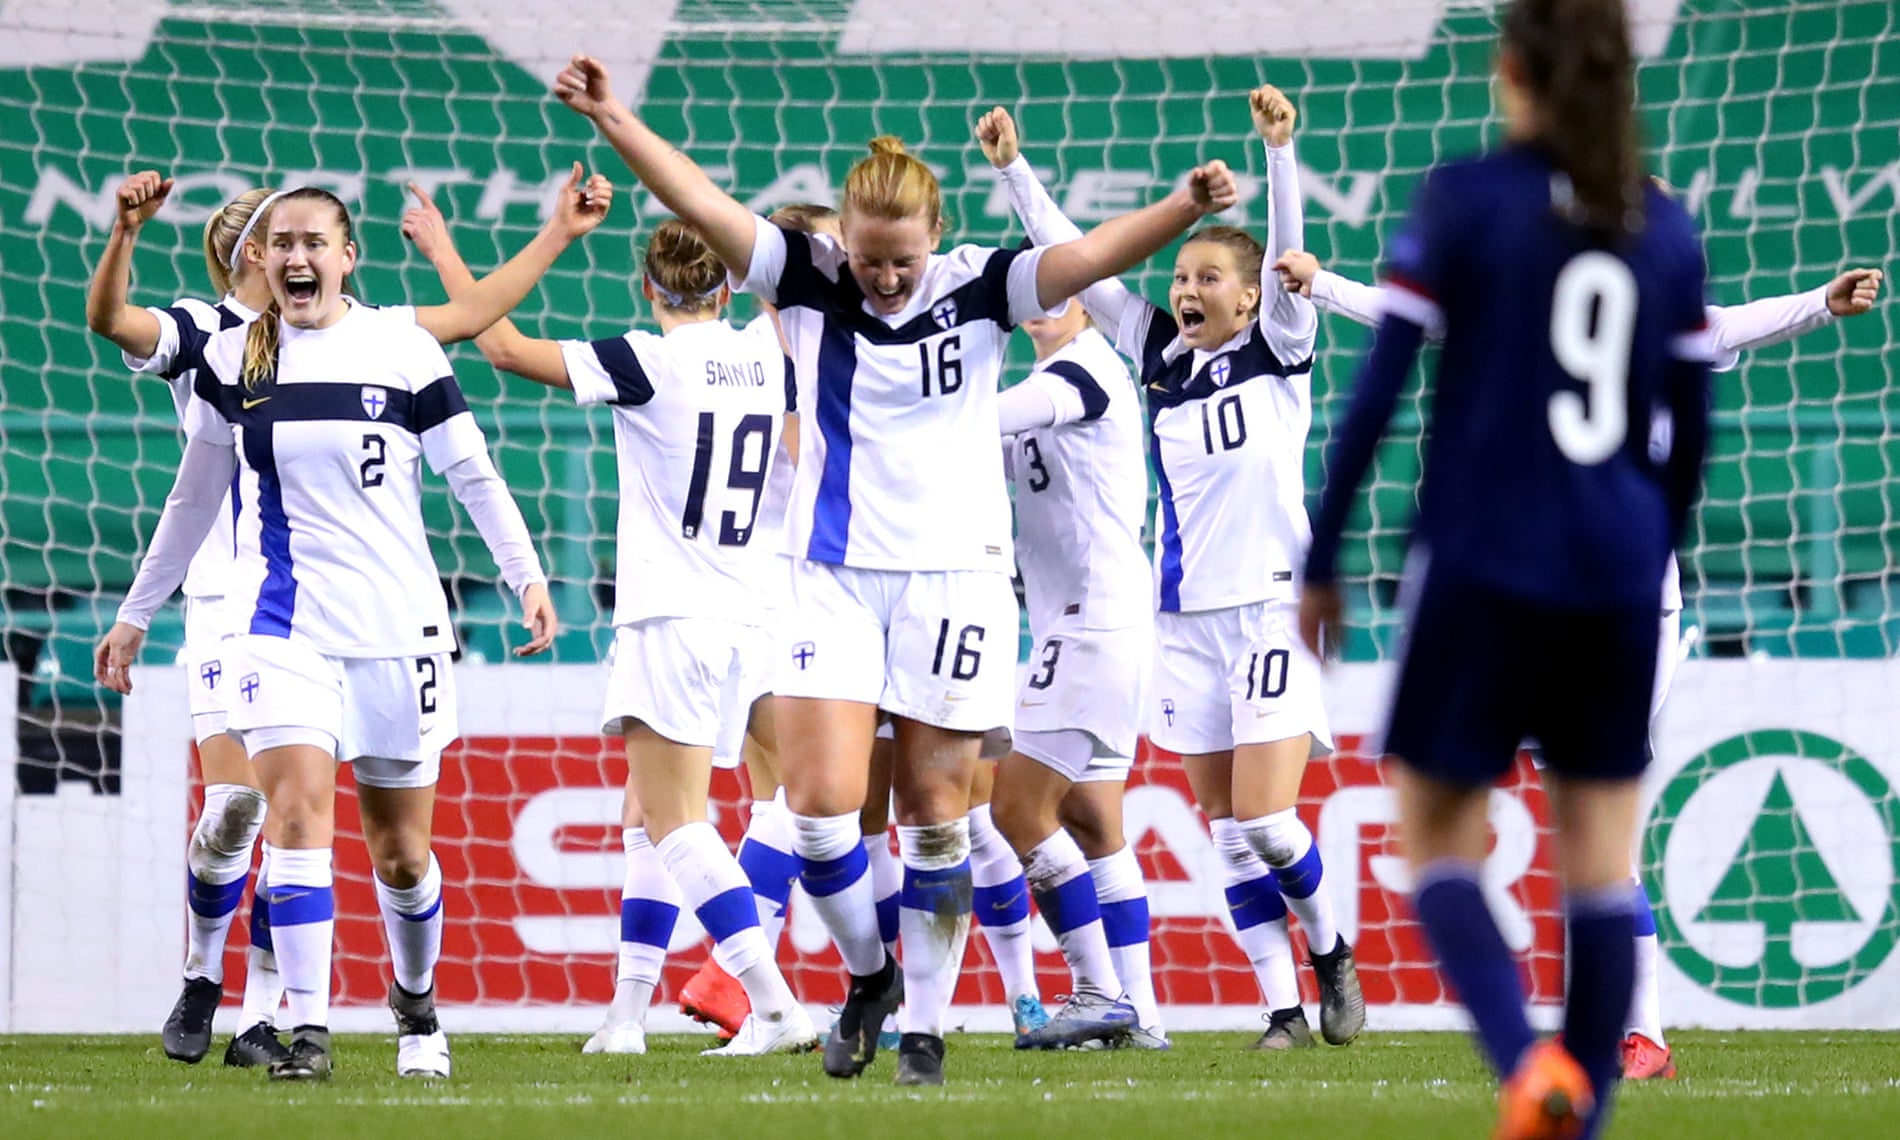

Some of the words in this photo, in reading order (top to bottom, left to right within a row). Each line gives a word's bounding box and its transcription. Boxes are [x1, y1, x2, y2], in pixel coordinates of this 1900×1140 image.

[706, 360, 765, 387] SAINIO
[920, 336, 963, 398] 16
[1548, 250, 1639, 465] 9
[1201, 394, 1247, 455] 10
[361, 433, 386, 489] 2
[682, 412, 773, 547] 19
[931, 618, 985, 681] 16
[1028, 639, 1063, 690] 3
[1246, 649, 1290, 700] 10
[415, 656, 436, 714] 2
[512, 785, 1536, 953] SAR
